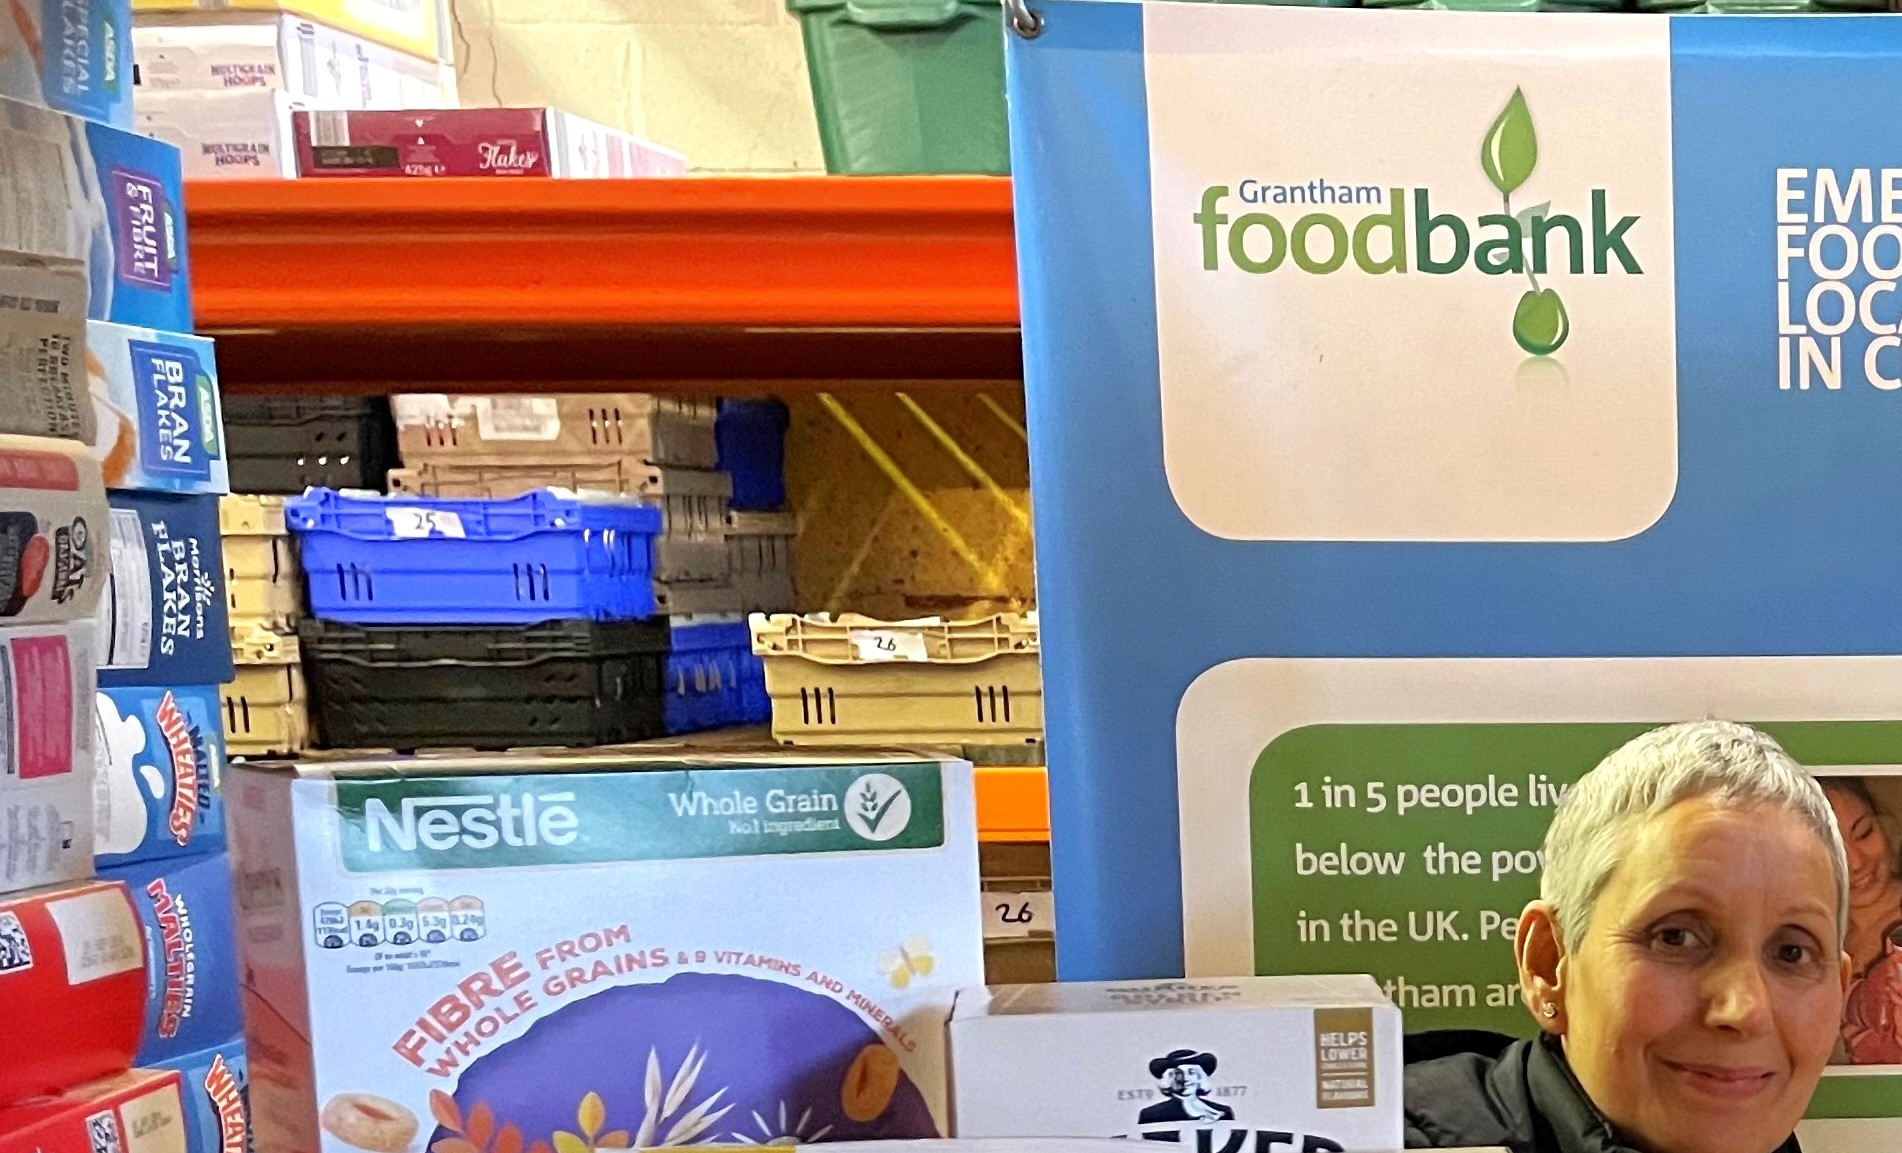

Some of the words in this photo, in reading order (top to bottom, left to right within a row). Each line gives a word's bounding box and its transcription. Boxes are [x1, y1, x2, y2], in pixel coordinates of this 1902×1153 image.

[211, 63, 275, 77] MULTIGRAIN
[223, 73, 266, 87] HOOPS
[201, 142, 270, 156] MULTIGRAIN
[215, 153, 260, 167] HOOPS
[1238, 178, 1382, 205] Grantham
[137, 184, 160, 278] FRUIT
[1193, 186, 1645, 275] foodbank
[1778, 335, 1843, 390] IN
[151, 357, 176, 463] FLAKES
[163, 360, 192, 464] BRAN
[413, 512, 436, 530] 25
[57, 516, 87, 605] OATS
[151, 520, 177, 656] FLAKES
[171, 539, 191, 638] BRAN
[190, 537, 205, 640] Morrisons
[873, 636, 896, 652] 26
[157, 690, 197, 848] WHEATIES
[668, 788, 757, 817] Whole
[766, 787, 839, 812] Grain
[1294, 782, 1314, 808] 1
[1321, 776, 1356, 808] in
[1366, 781, 1387, 813] 5
[1397, 774, 1519, 815] people
[1295, 842, 1406, 876] below
[1423, 842, 1482, 875] the
[995, 902, 1034, 924] 26
[1297, 910, 1331, 942] in
[1340, 910, 1398, 942] the
[1408, 910, 1468, 941] UK.
[147, 877, 185, 1039] MALTIES
[175, 893, 196, 1019] WHOLEGRAIN
[391, 950, 532, 1068] FIBRE
[535, 924, 632, 971] FROM
[425, 989, 539, 1078] WHOLE
[542, 947, 670, 998] GRAINS
[714, 949, 801, 977] VITAMINS
[805, 970, 843, 995] AND
[845, 989, 918, 1053] MINERALS
[1320, 1031, 1368, 1047] HELPS
[1320, 1047, 1368, 1062] LOWER
